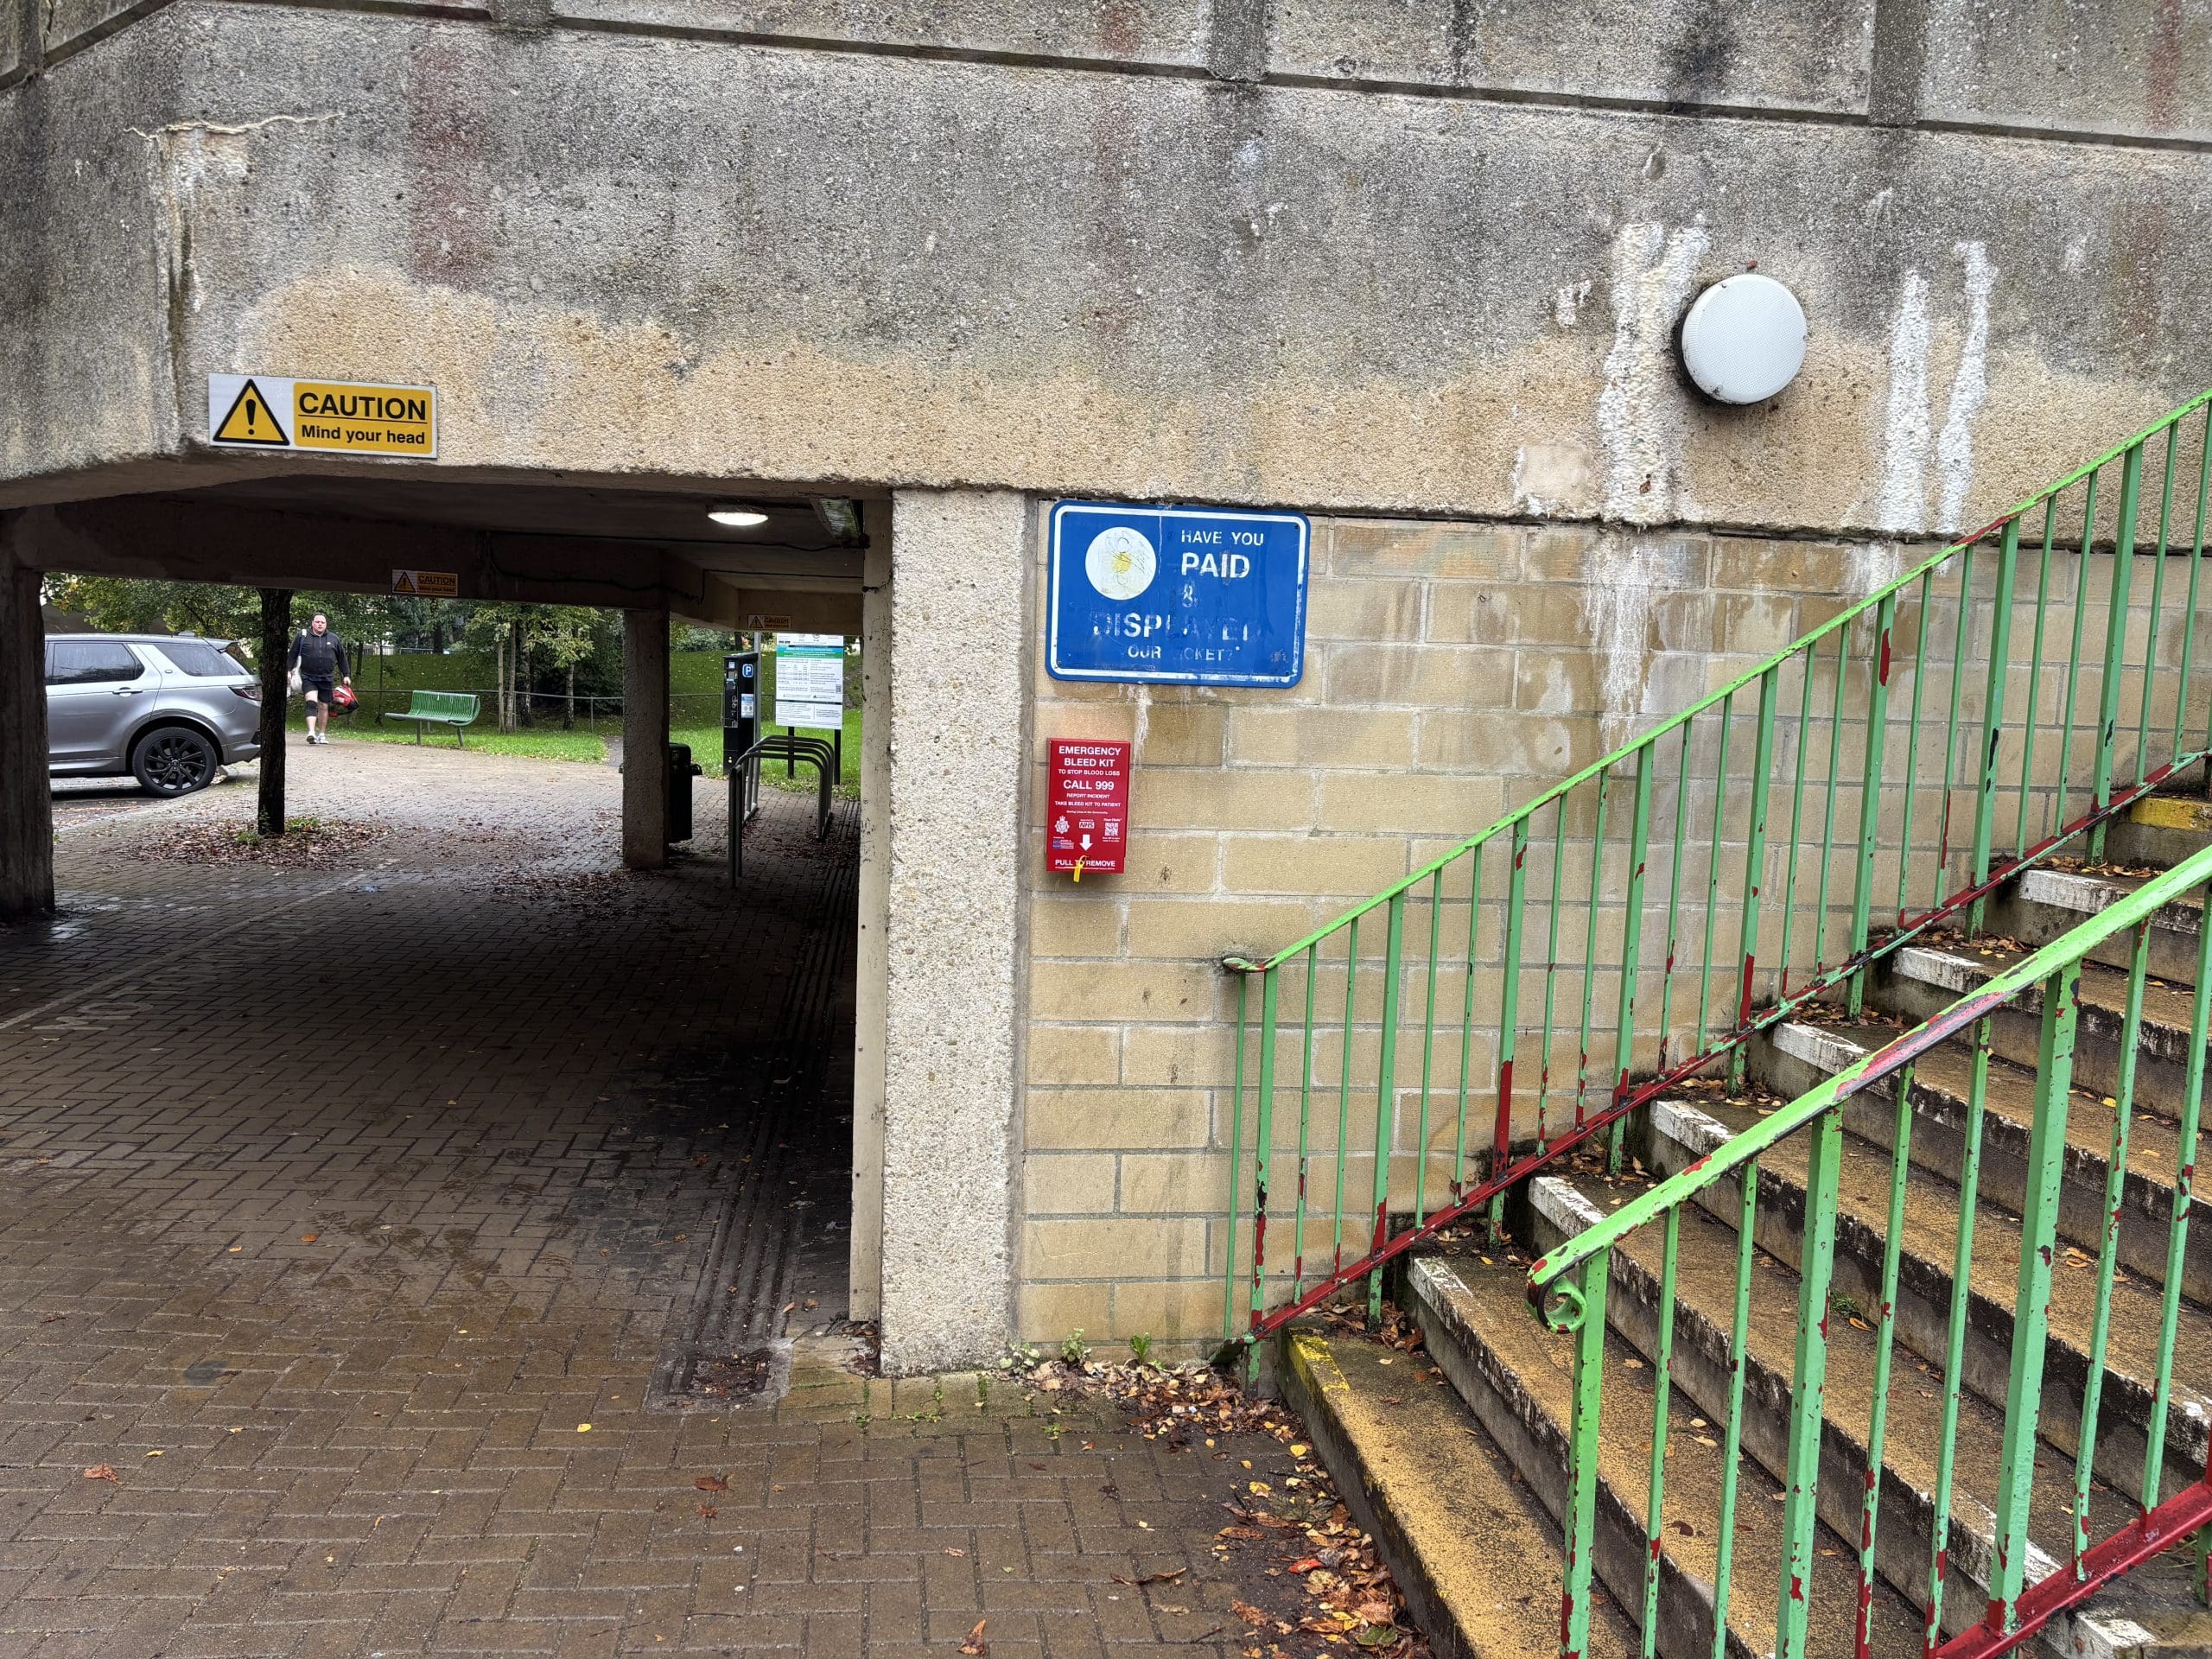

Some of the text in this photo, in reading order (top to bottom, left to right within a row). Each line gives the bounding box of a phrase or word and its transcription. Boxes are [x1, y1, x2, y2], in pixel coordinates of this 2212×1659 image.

[299, 392, 426, 420] CAUTION
[302, 424, 425, 444] Mind your head
[1181, 530, 1264, 545] HAVE YOU
[1181, 551, 1250, 578] PAID
[418, 575, 456, 585] CAUTION
[1122, 645, 1162, 659] OUR
[745, 665, 752, 676] P
[1058, 746, 1122, 756] EMERGENCY
[1064, 758, 1116, 767] BLEED KIT
[1063, 779, 1115, 791] CALL 999
